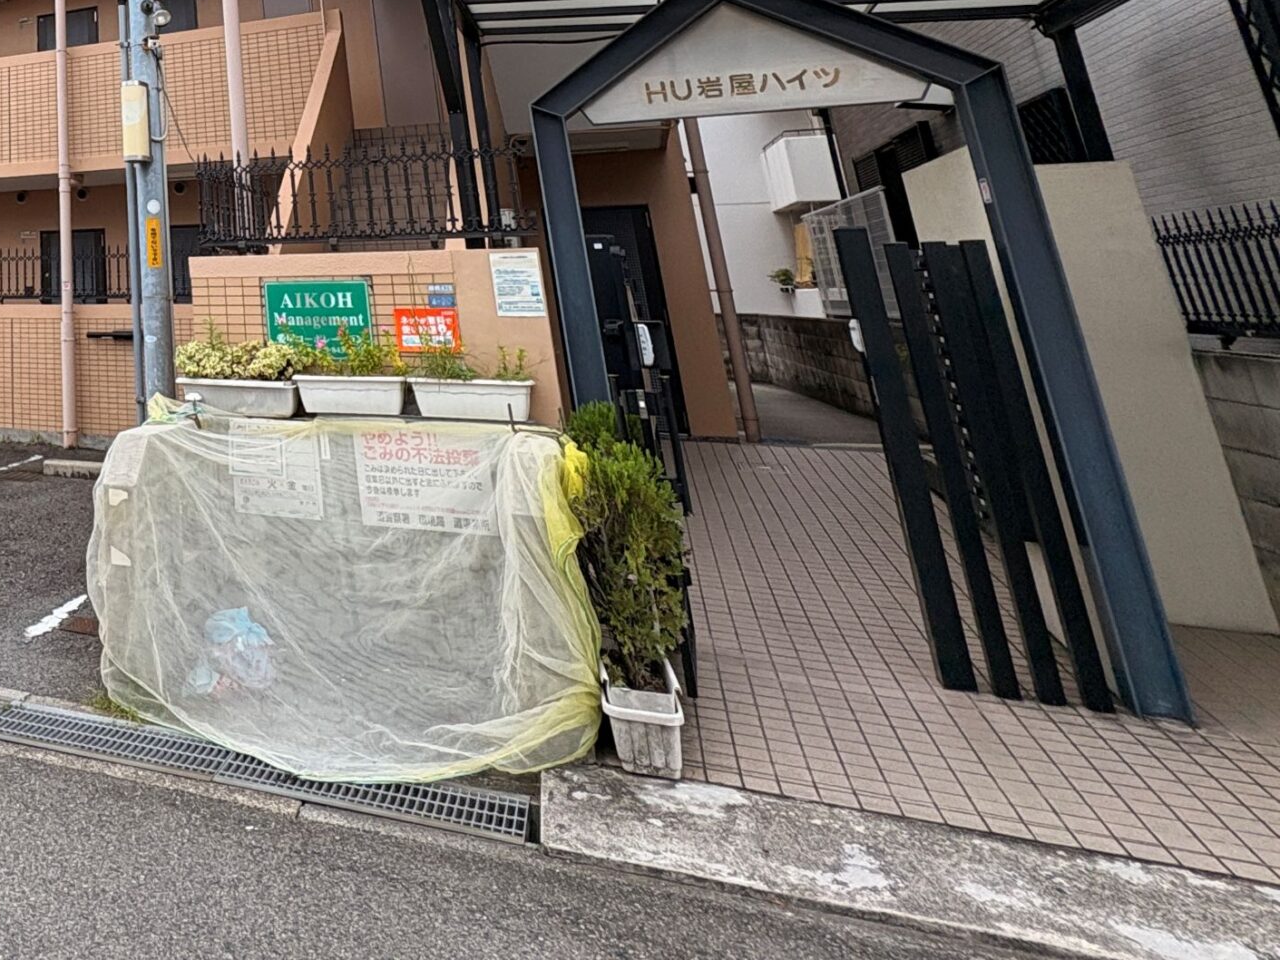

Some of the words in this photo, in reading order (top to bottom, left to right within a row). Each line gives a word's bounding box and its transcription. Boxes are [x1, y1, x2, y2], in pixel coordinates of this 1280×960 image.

[644, 67, 841, 105] HU岩屋ハイツ
[280, 291, 354, 309] AIKOH
[273, 311, 365, 330] Management
[363, 446, 480, 467] ごみの不法投棄
